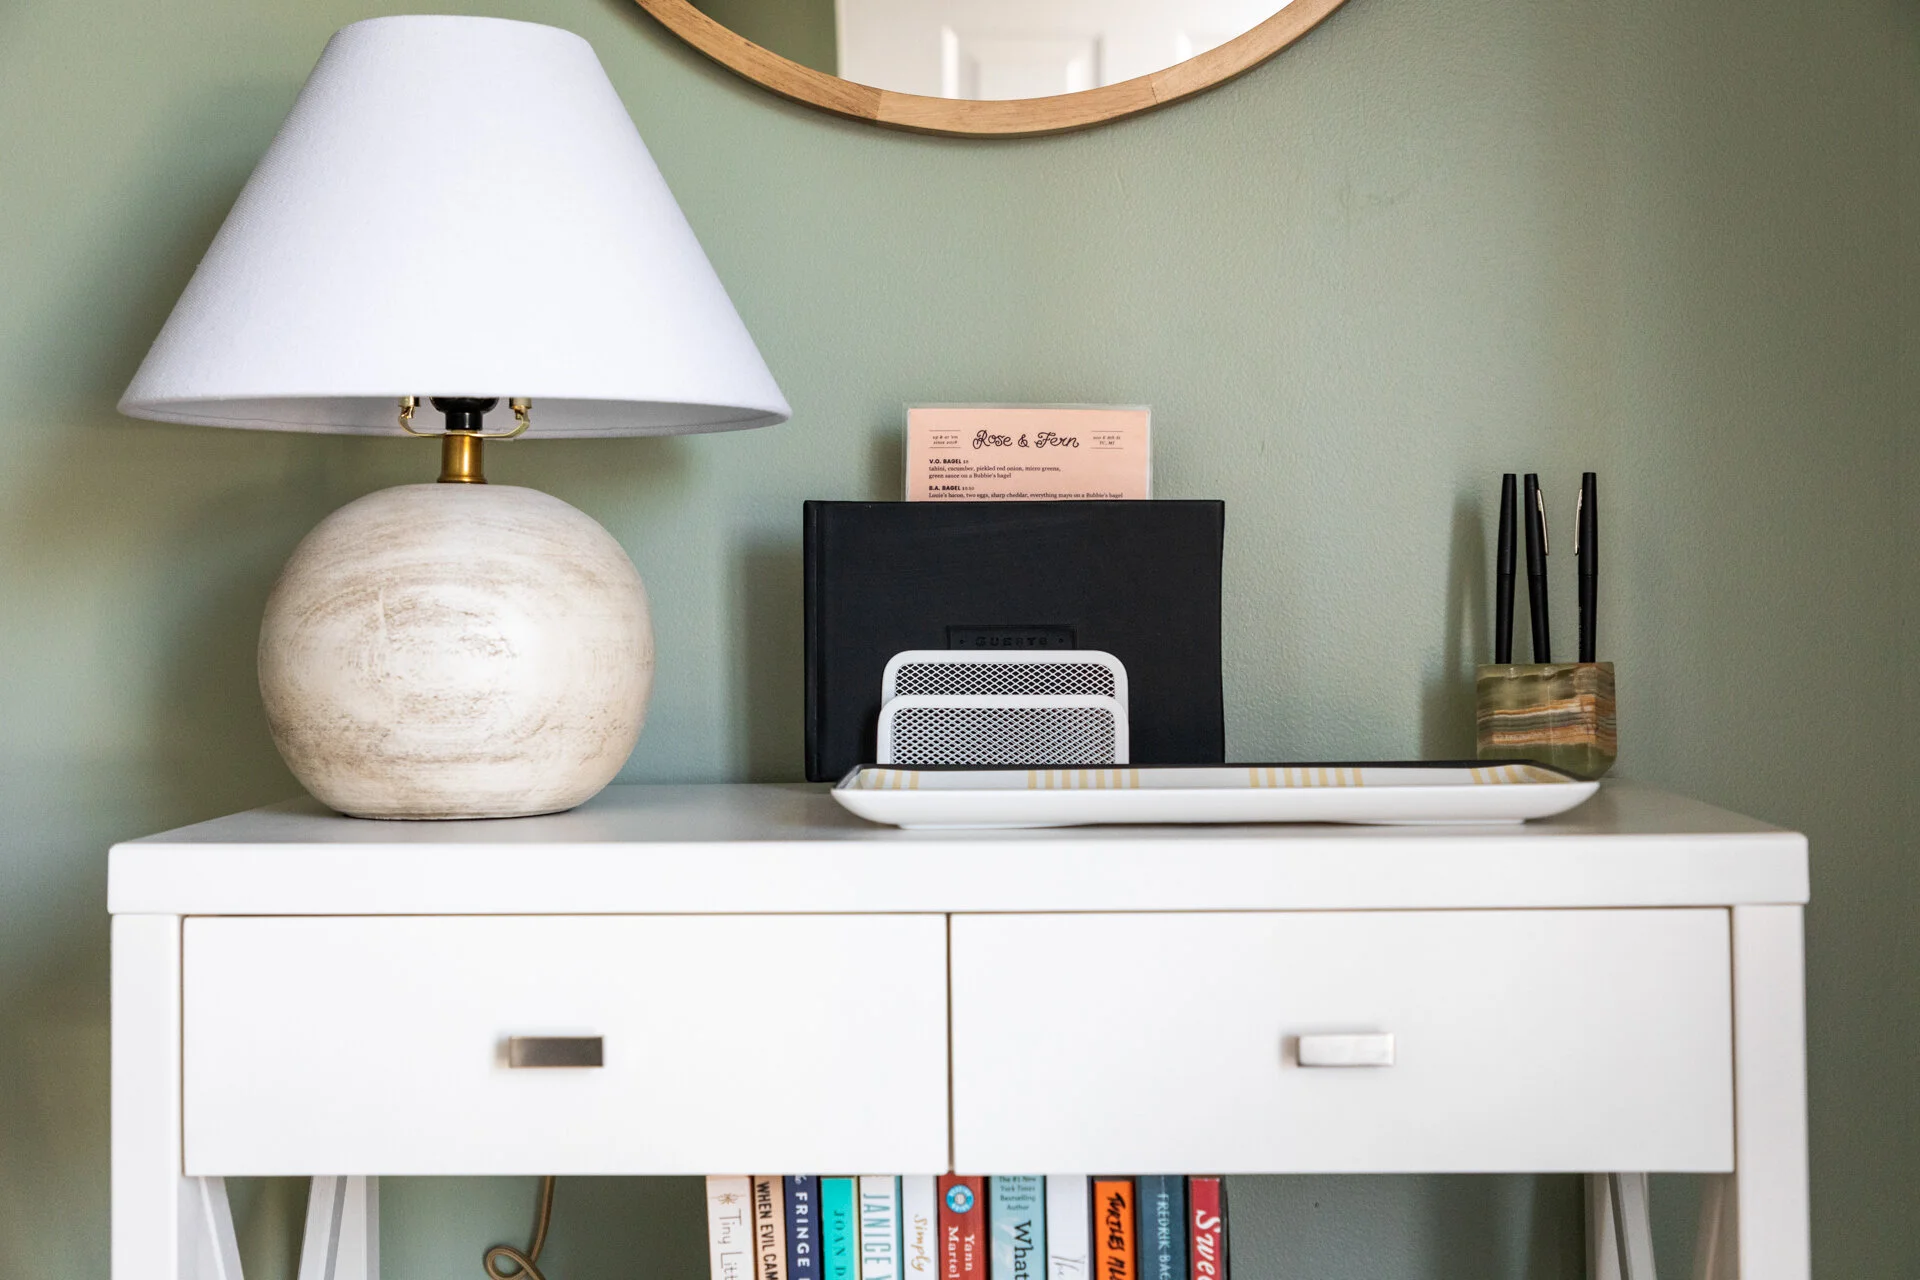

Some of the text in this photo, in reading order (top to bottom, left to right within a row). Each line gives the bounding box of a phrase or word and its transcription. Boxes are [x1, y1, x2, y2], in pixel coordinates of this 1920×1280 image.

[972, 429, 1080, 449] Rose & Fern
[996, 472, 1012, 480] bagel
[756, 1181, 772, 1219] WHEN
[1000, 1194, 1037, 1203] Bestselling
[1156, 1193, 1171, 1250] FREDRIK
[718, 1208, 742, 1245] Tiny
[760, 1224, 776, 1252] EVIL
[795, 1192, 810, 1267] FRINGE
[833, 1210, 846, 1256] JOAN
[863, 1193, 892, 1264] JANICE
[910, 1213, 932, 1272] Simply
[1105, 1192, 1126, 1252] TURTLES
[947, 1226, 960, 1278] Martel
[964, 1233, 976, 1271] Yann
[1013, 1220, 1034, 1280] What
